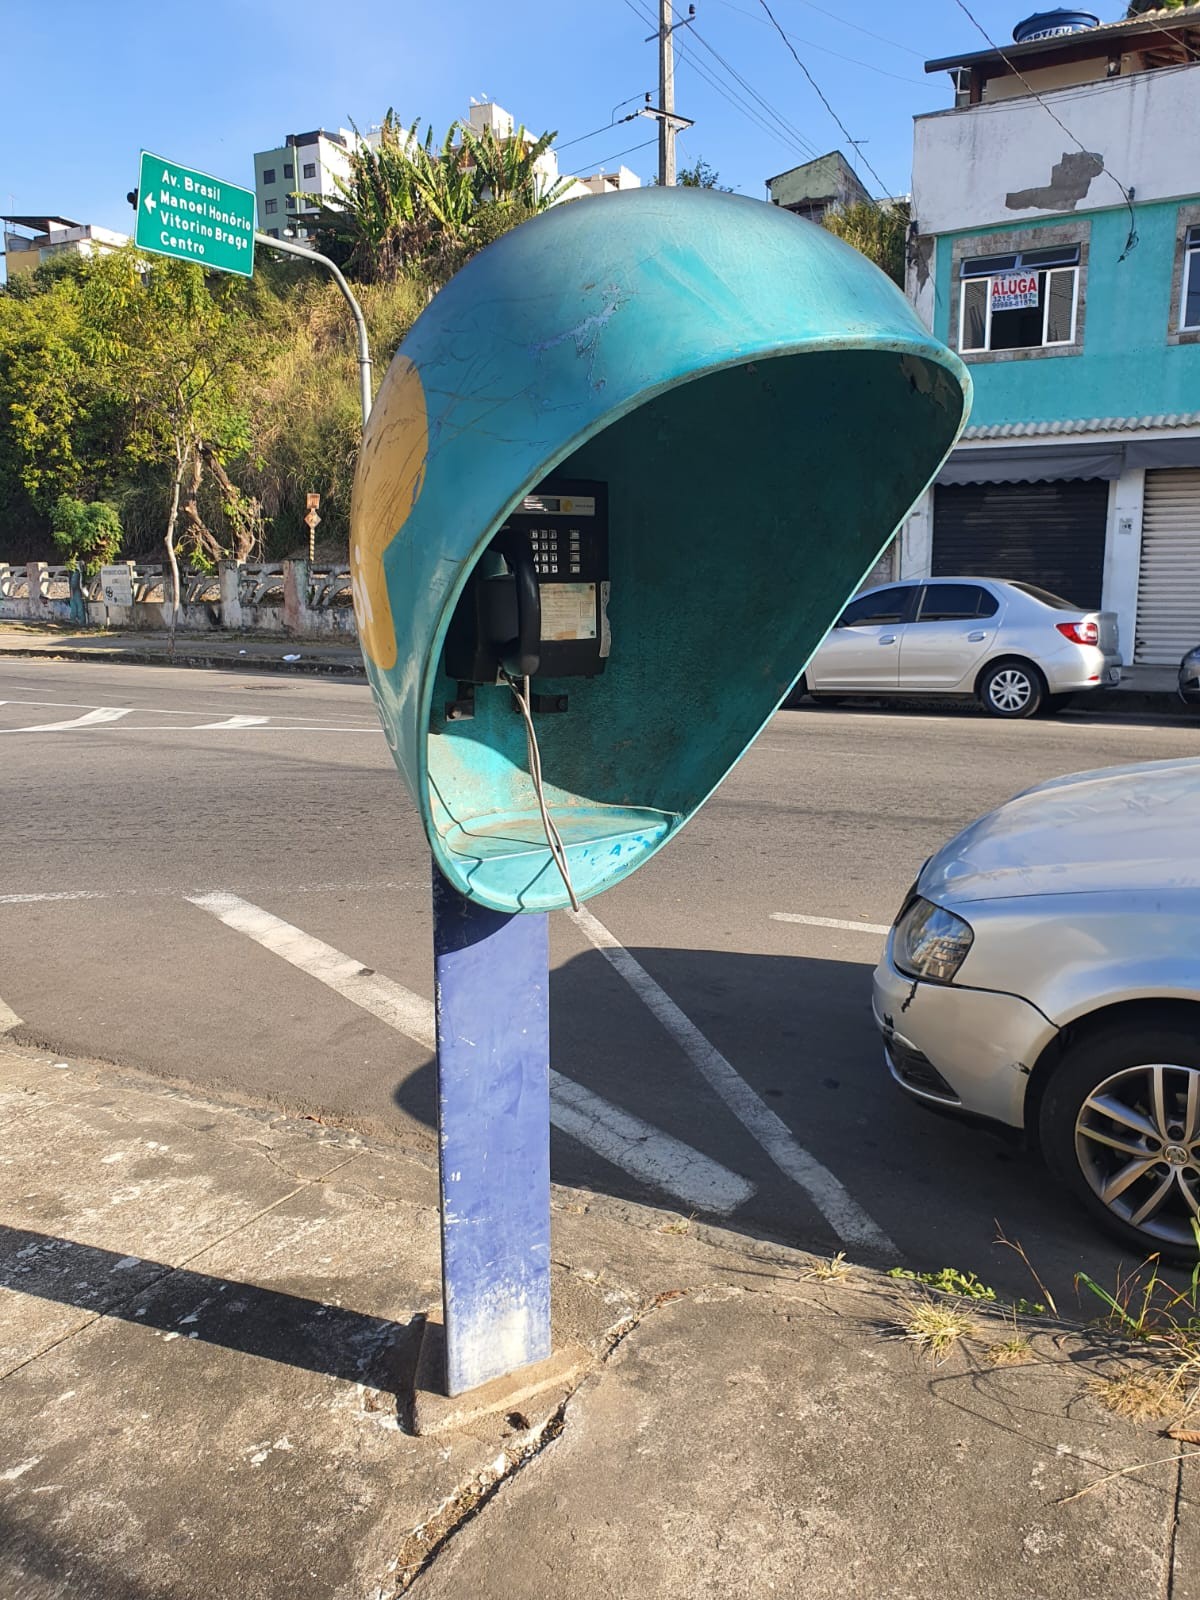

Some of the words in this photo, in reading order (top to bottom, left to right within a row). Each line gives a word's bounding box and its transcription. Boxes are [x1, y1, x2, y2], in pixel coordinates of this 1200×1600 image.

[162, 169, 180, 188] Av.
[184, 176, 220, 202] Brasil
[160, 190, 207, 216] Manoel
[209, 204, 251, 231] Honório
[160, 210, 213, 238] Vitorino
[215, 227, 248, 250] Braga
[160, 231, 205, 255] Centro
[992, 277, 1037, 297] ALUGA
